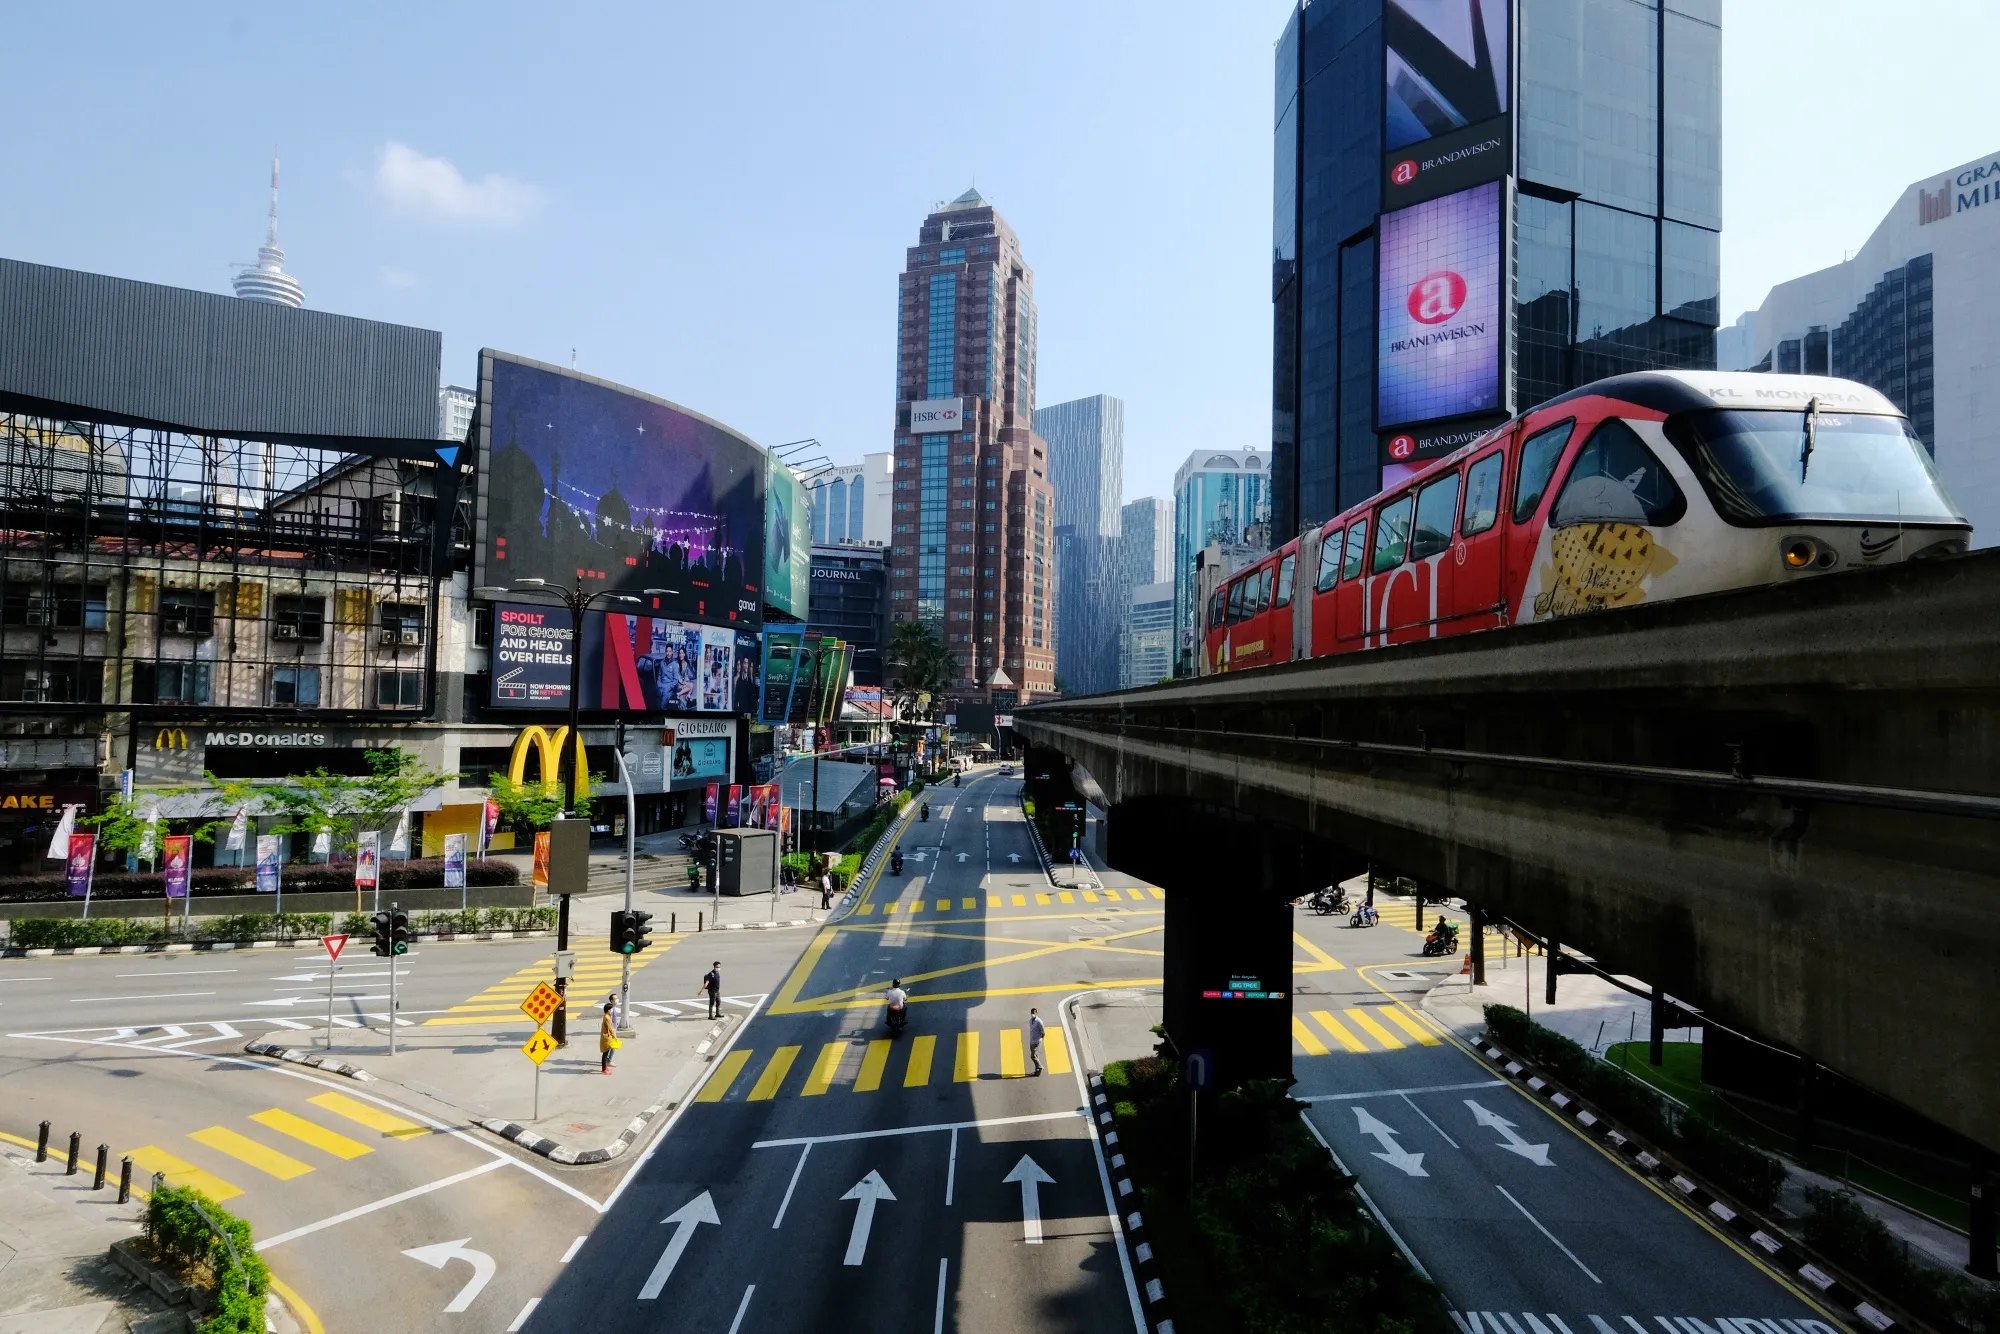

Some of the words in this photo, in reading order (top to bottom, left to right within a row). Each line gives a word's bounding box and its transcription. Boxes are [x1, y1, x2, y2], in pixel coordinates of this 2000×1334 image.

[1422, 138, 1500, 171] BRANDAVISION
[1391, 323, 1485, 353] BRANDAVISION
[1709, 388, 1742, 398] KL
[913, 411, 941, 422] HSBC
[1420, 429, 1493, 449] BRANDAVISIO
[811, 569, 861, 580] JOURNAL
[501, 611, 545, 624] SPOILT
[500, 623, 527, 637] FOR
[528, 626, 573, 640] CHOICE
[500, 638, 528, 648] AND
[530, 640, 563, 651] HEAD
[499, 650, 534, 663] OVER
[535, 652, 573, 665] HEELS
[767, 673, 784, 682] Swift
[677, 721, 727, 736] GIORDANO
[204, 732, 325, 746] McDonald's
[0, 795, 55, 809] AKE
